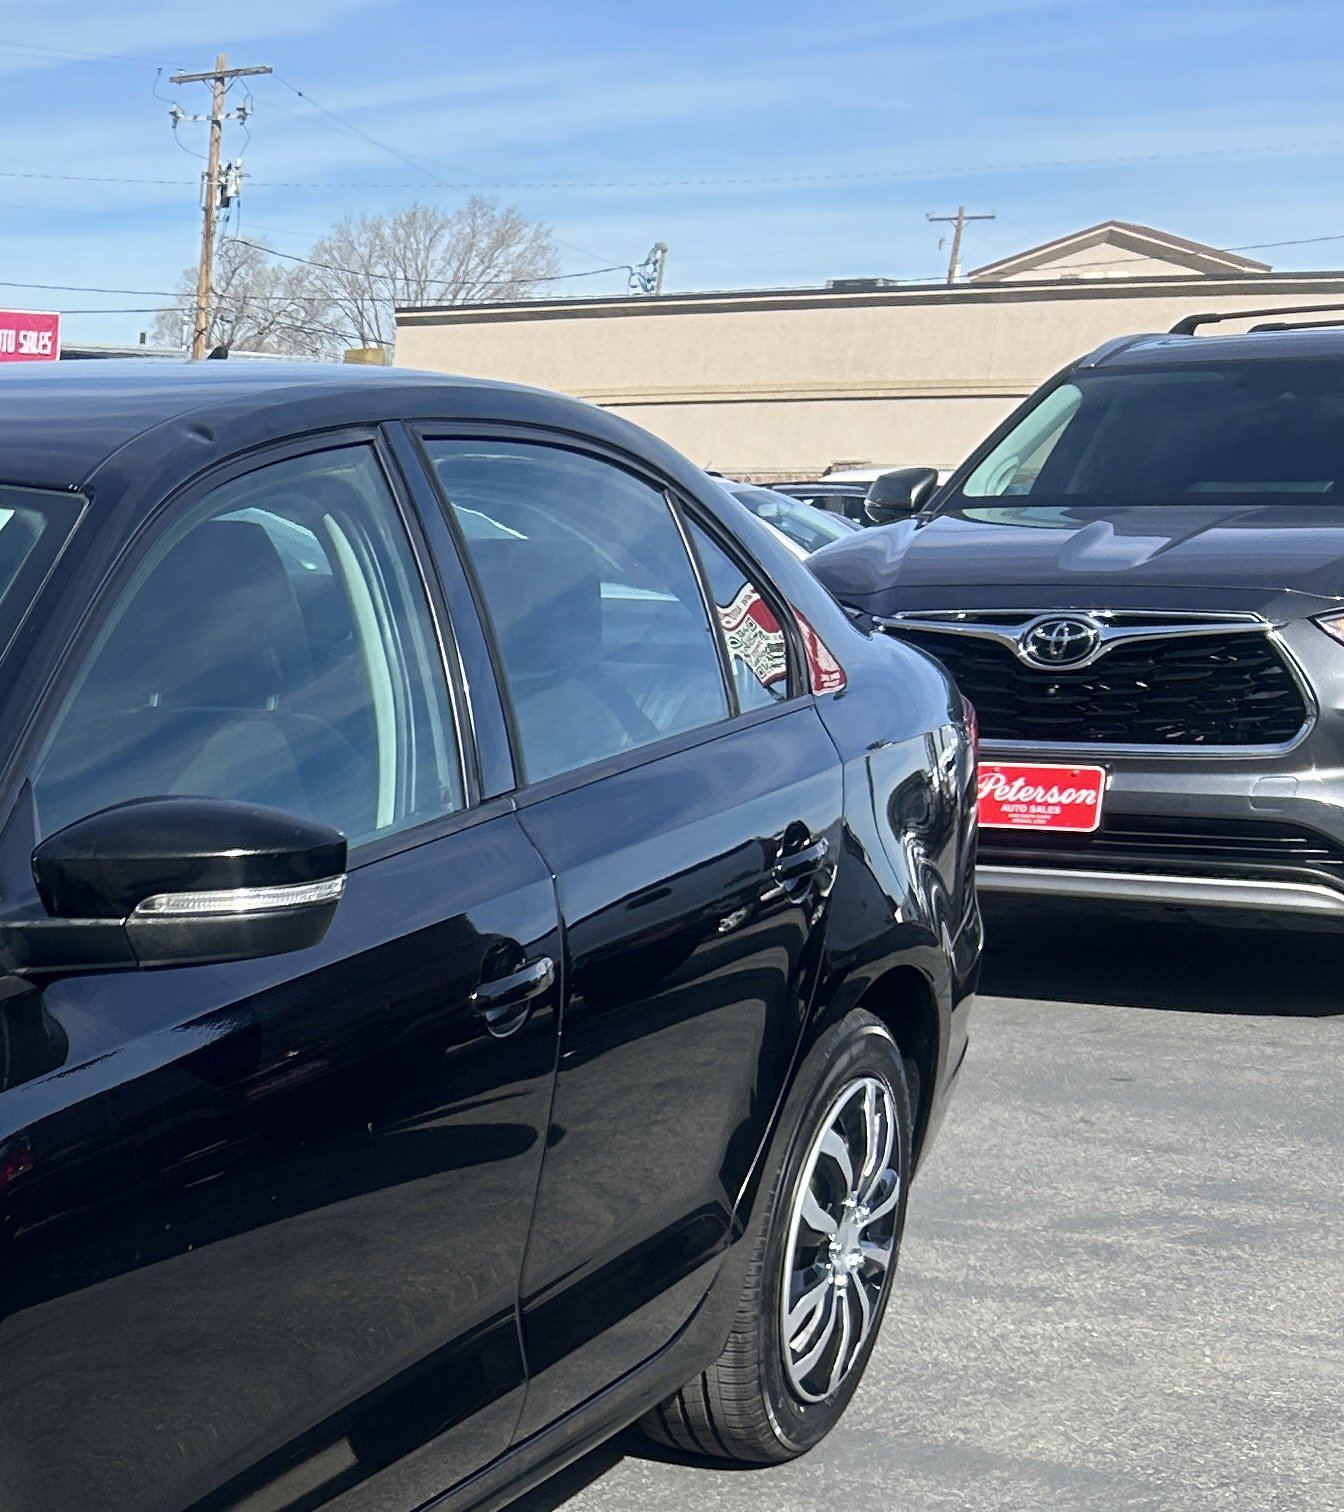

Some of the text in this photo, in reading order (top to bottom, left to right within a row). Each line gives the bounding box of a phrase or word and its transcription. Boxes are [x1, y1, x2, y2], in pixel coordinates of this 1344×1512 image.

[19, 329, 53, 355] SALES
[978, 773, 1096, 805] Peterson
[1000, 803, 1061, 815] AUTO SALES
